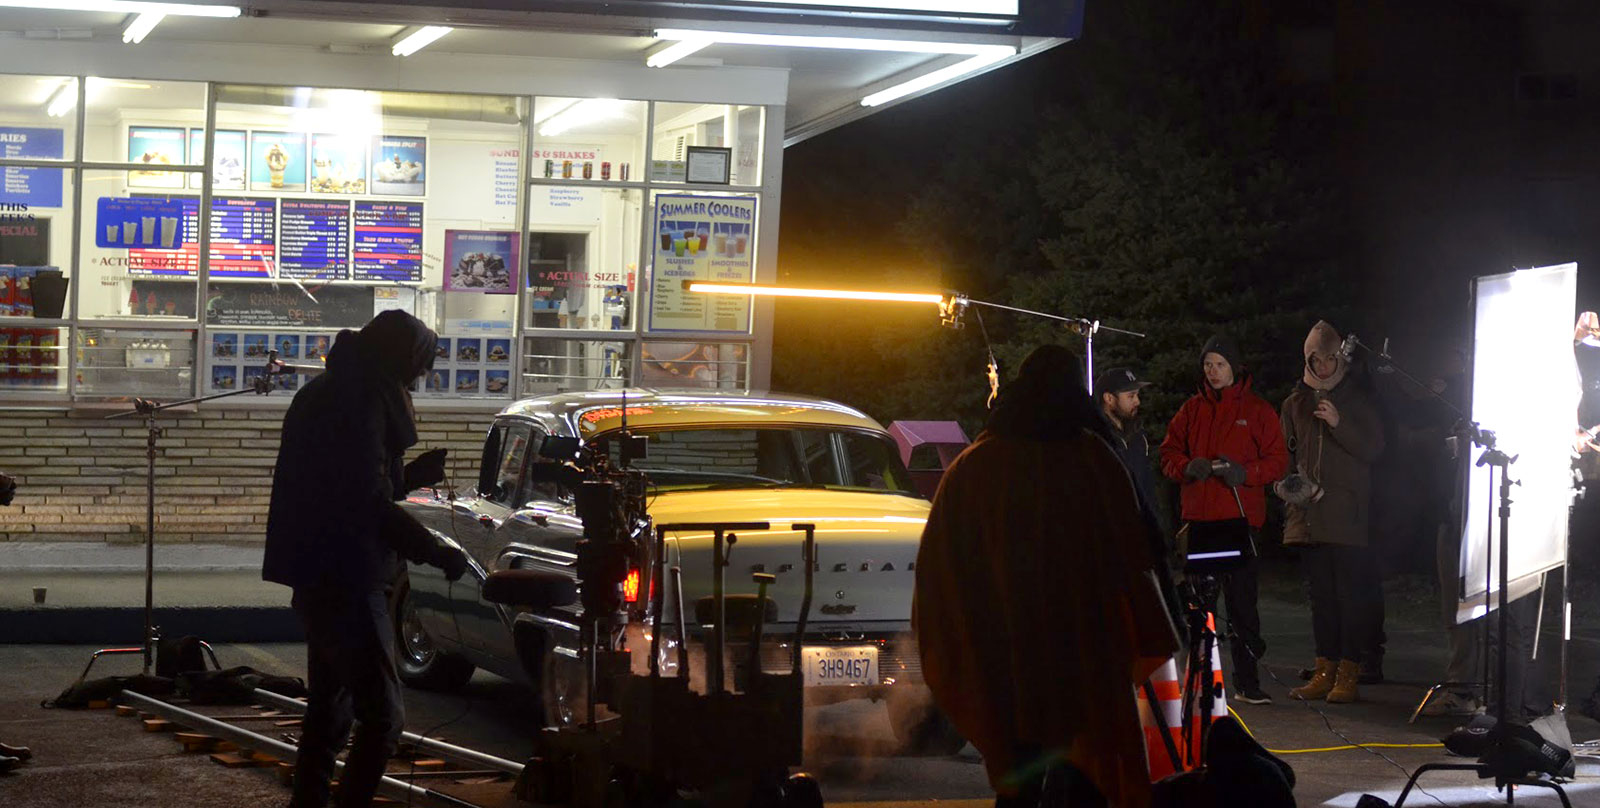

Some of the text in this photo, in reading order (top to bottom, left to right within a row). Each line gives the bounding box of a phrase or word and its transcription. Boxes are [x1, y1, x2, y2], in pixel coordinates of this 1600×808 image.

[489, 149, 595, 159] SUNDS & SHAKES
[0, 202, 28, 212] THIS
[660, 201, 752, 220] SUMMER COOLERS
[100, 256, 146, 267] ACTUAL
[546, 271, 620, 282] ACTUAL SIZE
[288, 309, 322, 322] DELITE
[818, 659, 870, 679] 3H9467
